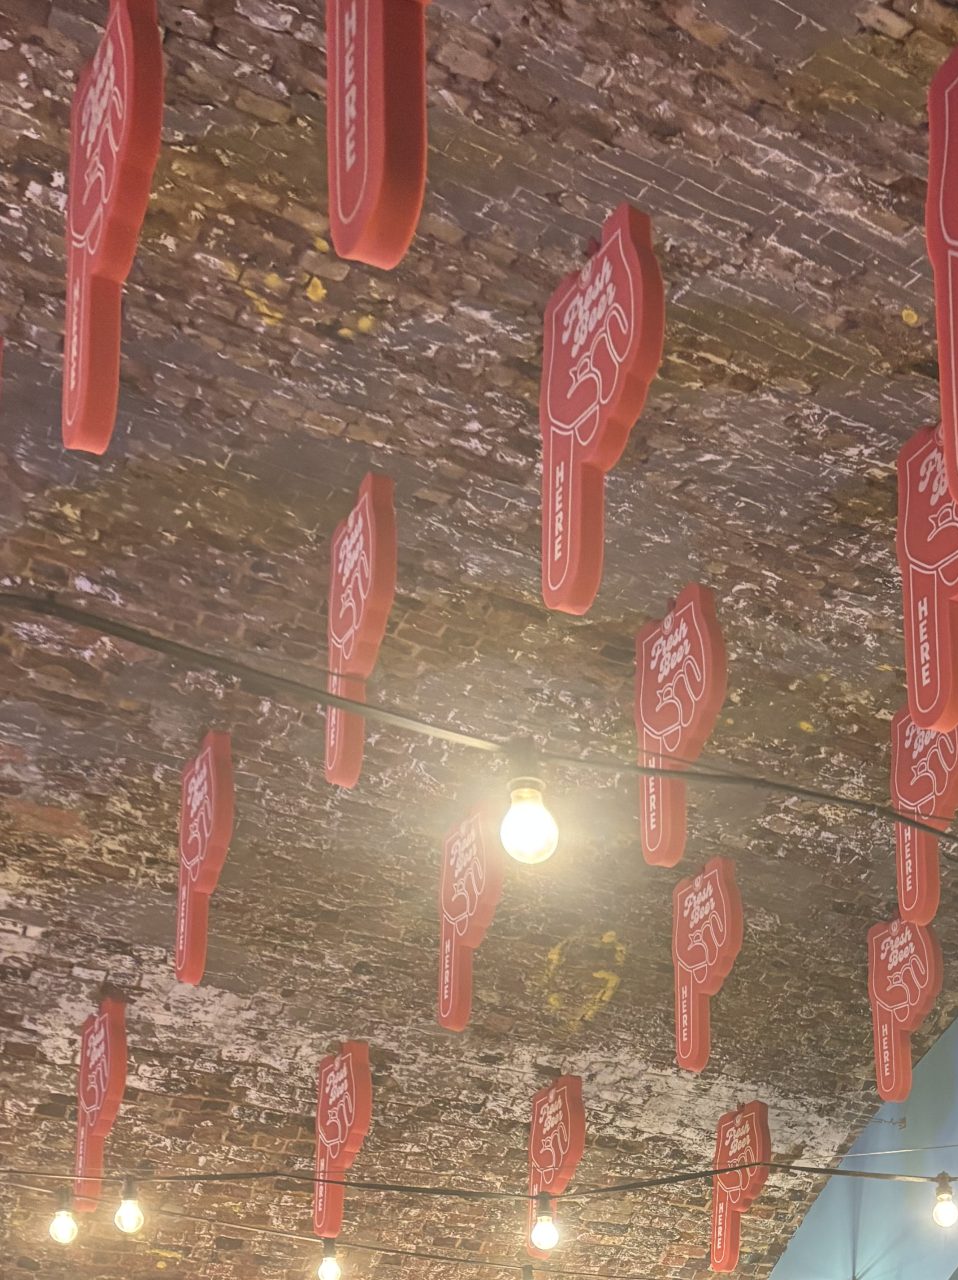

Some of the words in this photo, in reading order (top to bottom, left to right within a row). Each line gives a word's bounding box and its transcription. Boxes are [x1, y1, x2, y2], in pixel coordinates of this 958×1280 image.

[554, 461, 565, 561] HERE
[918, 597, 931, 687] HERE
[903, 826, 913, 891] HERE
[880, 926, 912, 960] Fresh
[887, 942, 915, 971] Beer
[680, 986, 688, 1042] HERE
[881, 1024, 890, 1076] HERE
[716, 1202, 724, 1249] HERE
